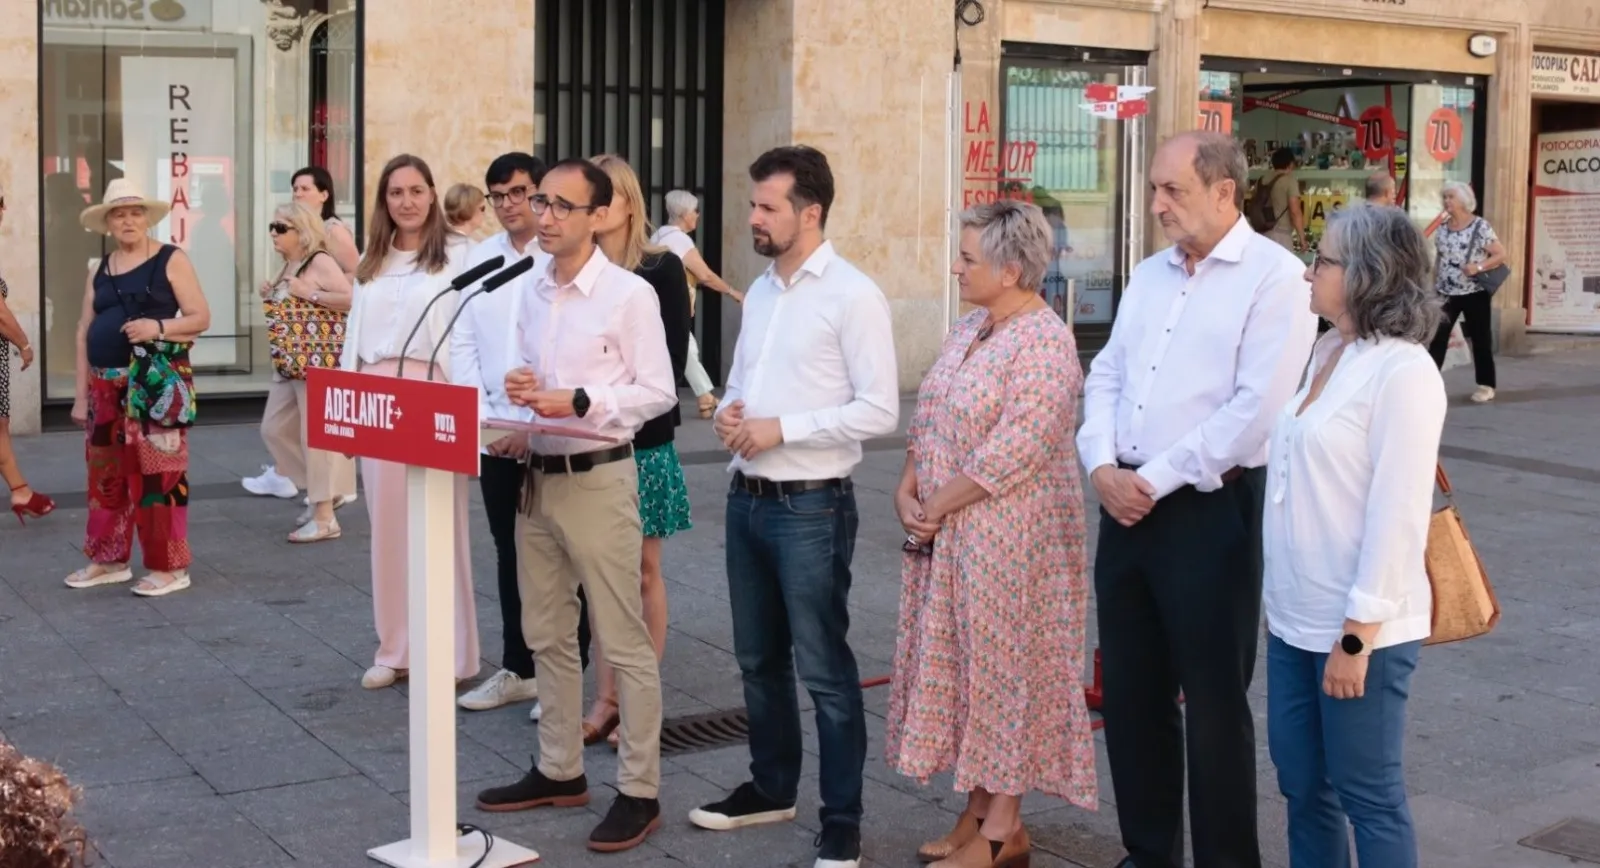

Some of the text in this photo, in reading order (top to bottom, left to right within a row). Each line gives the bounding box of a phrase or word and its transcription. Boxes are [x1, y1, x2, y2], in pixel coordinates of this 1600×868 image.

[1570, 56, 1600, 83] CAL
[965, 101, 990, 133] LA
[965, 140, 1037, 173] MEJOR
[1541, 138, 1600, 152] FOTOCOPIA
[1543, 156, 1600, 175] CALCO
[324, 386, 396, 431] ADELANTE
[434, 412, 456, 434] VOTA
